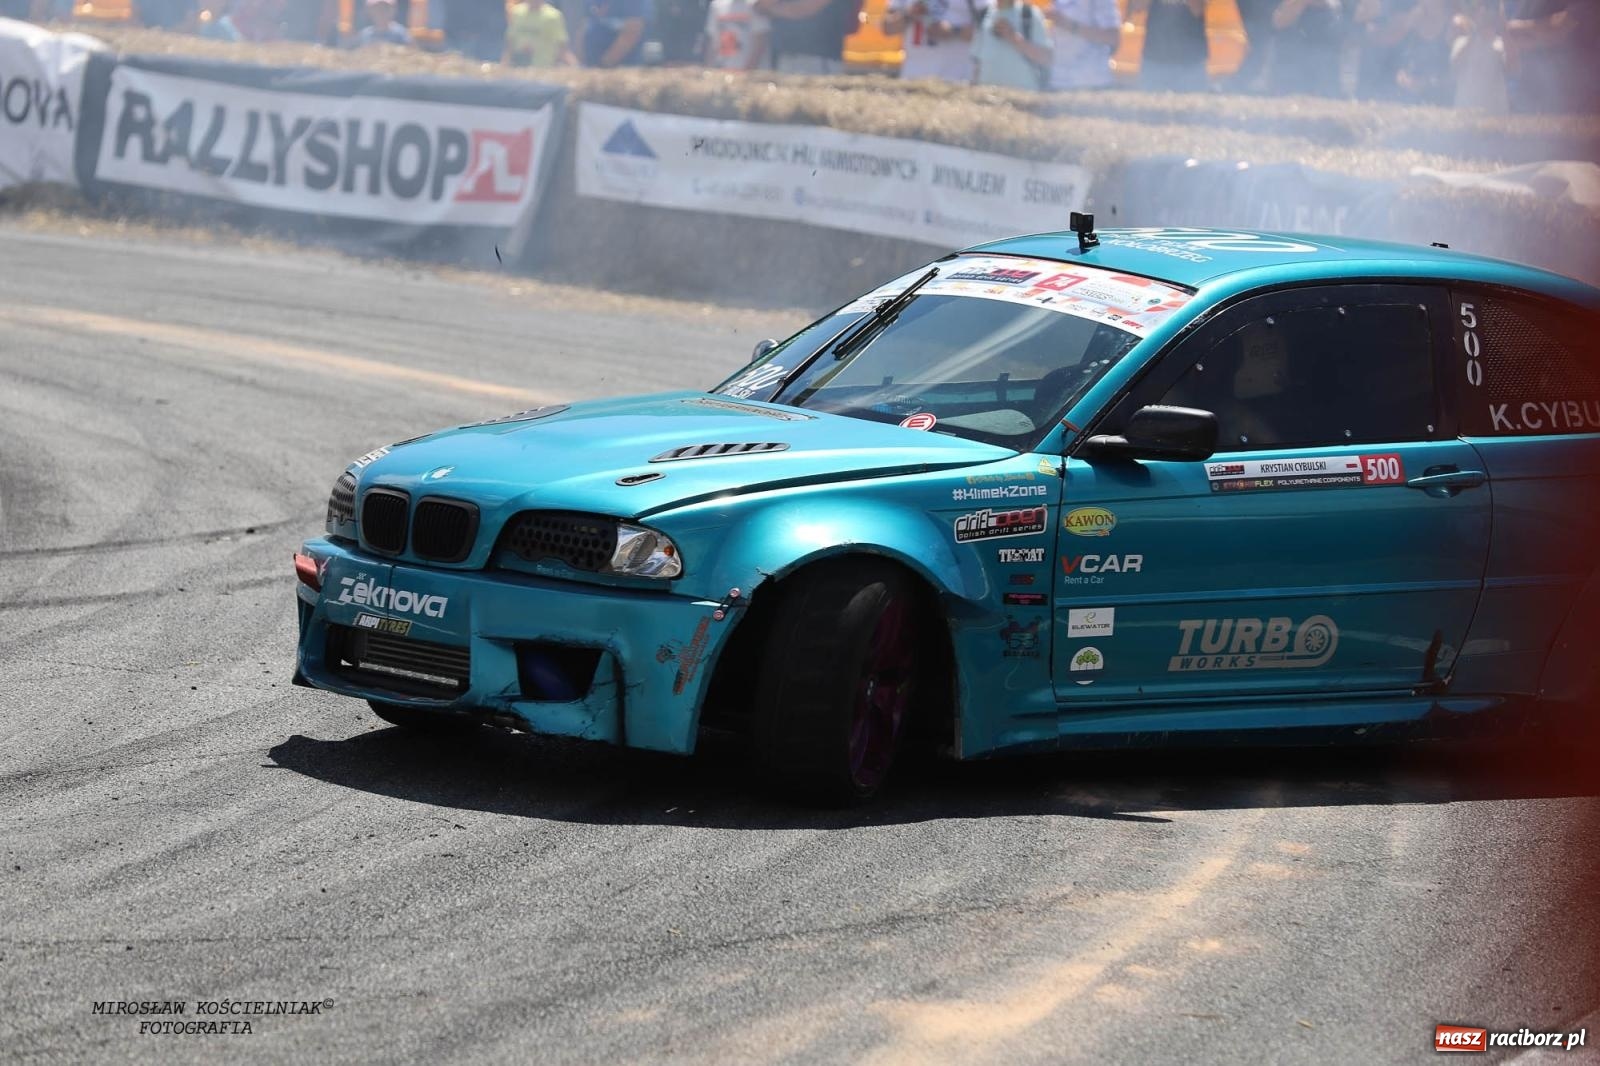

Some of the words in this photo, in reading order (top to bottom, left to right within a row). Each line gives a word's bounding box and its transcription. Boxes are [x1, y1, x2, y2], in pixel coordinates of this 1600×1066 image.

[0, 76, 74, 132] OVA
[113, 90, 469, 202] RALLYSHOP
[1260, 462, 1295, 474] KRYSTIAN
[1295, 461, 1327, 472] CYBULSKI
[1367, 458, 1399, 481] 500
[952, 485, 1047, 500] #KlimekZone
[1064, 513, 1115, 528] KAWON
[959, 530, 985, 540] polish
[989, 527, 1010, 536] drift
[1013, 523, 1043, 532] series
[1061, 554, 1143, 575] VCAR
[1064, 576, 1083, 584] Rent
[1090, 575, 1105, 584] Car
[1179, 656, 1257, 670] WORKS
